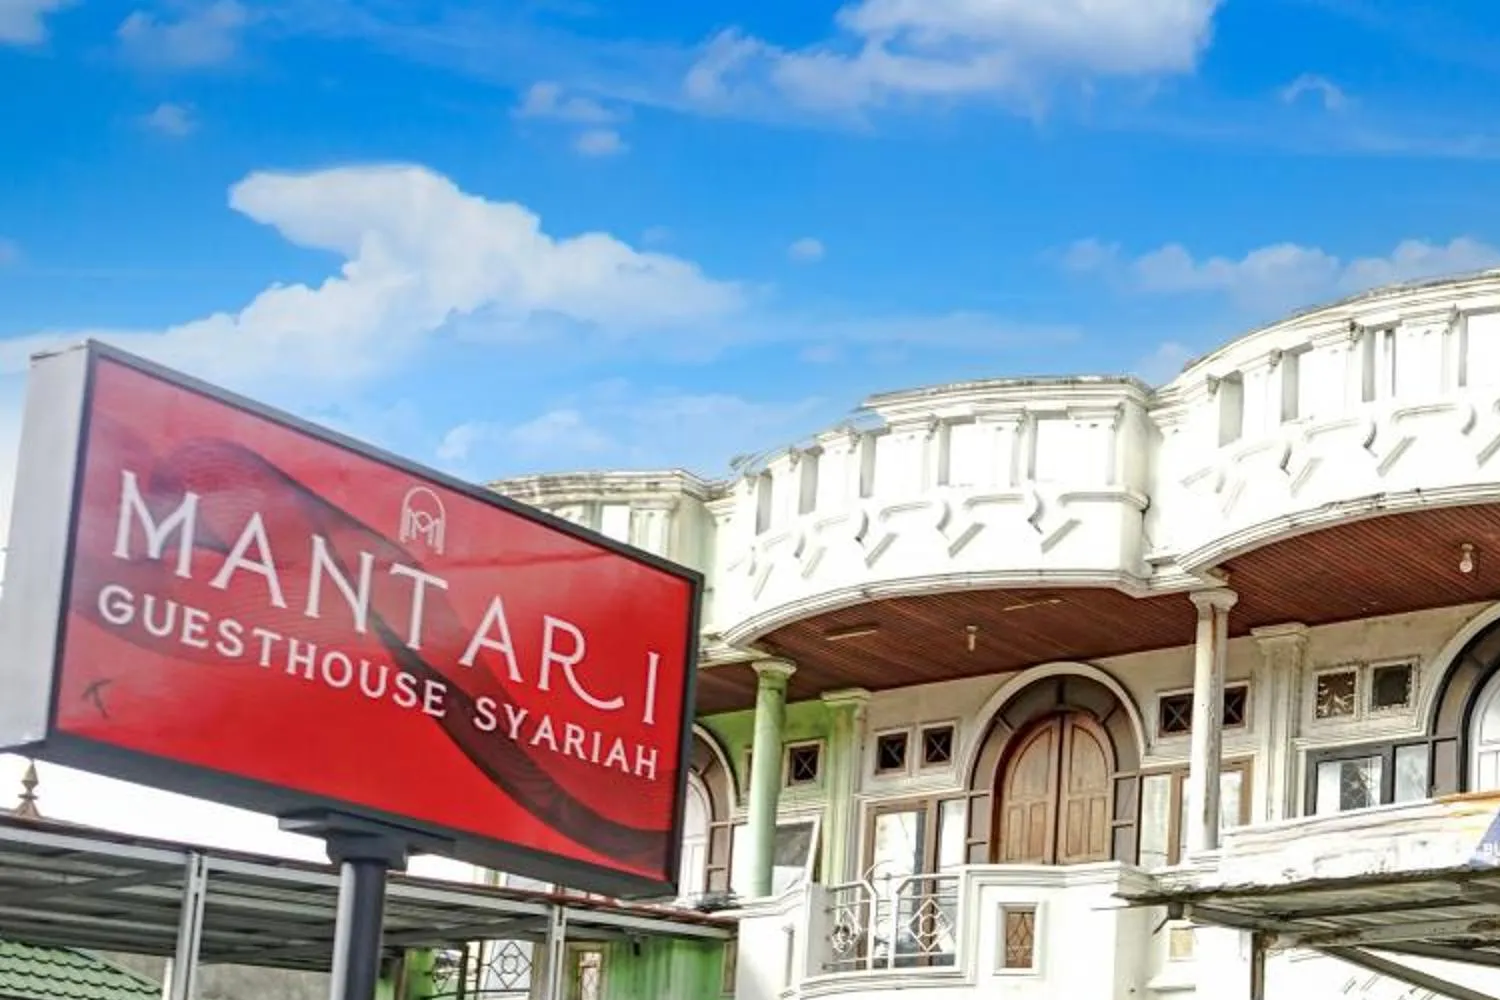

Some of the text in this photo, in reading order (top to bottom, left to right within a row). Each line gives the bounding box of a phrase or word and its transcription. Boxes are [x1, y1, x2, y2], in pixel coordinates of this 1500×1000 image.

[98, 584, 659, 781] GUESTHOUSE SYARIAH
[112, 469, 660, 725] MANTARI
